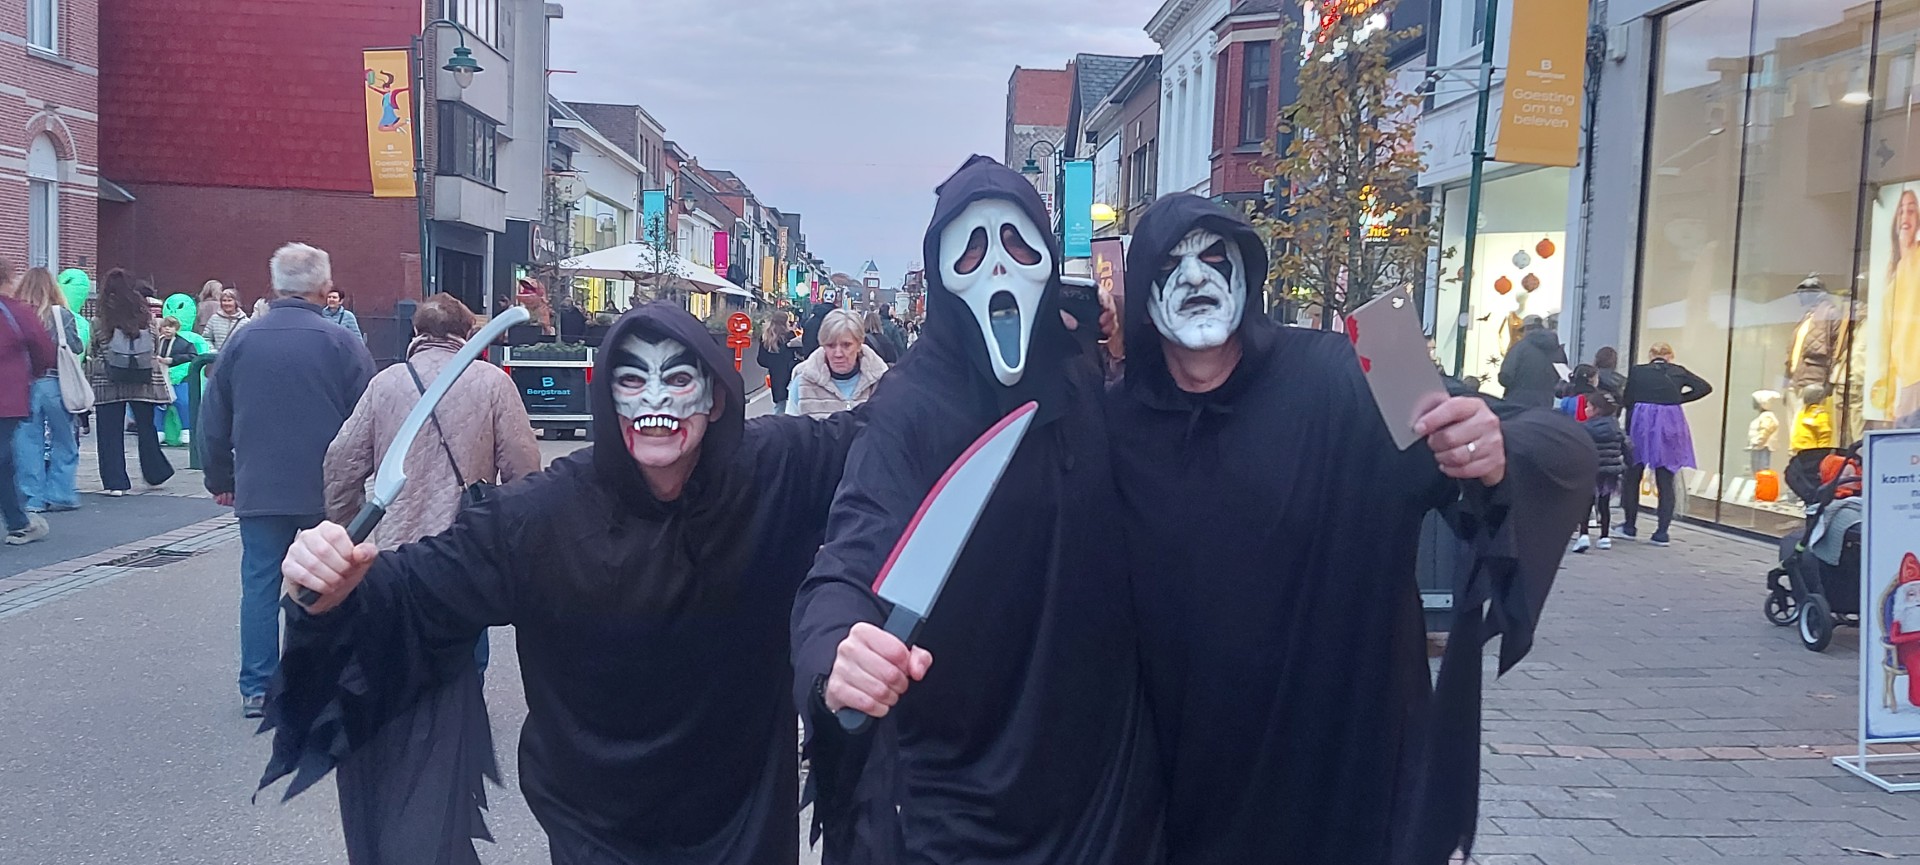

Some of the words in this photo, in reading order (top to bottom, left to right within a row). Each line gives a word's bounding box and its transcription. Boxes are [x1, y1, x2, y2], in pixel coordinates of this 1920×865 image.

[1512, 88, 1576, 106] Goesting
[1522, 103, 1545, 113] om
[1549, 105, 1563, 115] te
[1513, 114, 1569, 128] beleven
[542, 377, 555, 387] B
[1882, 474, 1915, 484] komt
